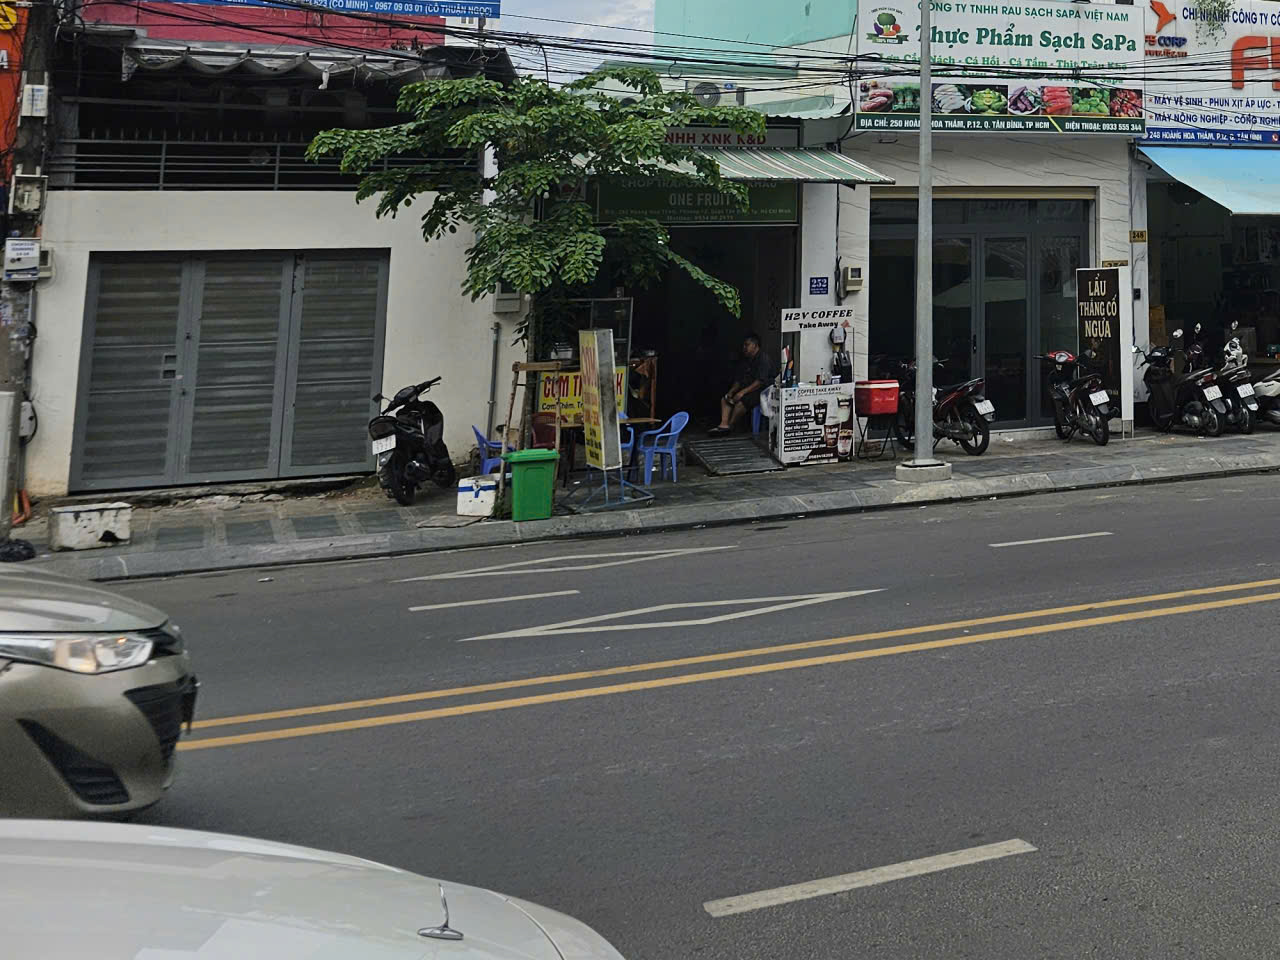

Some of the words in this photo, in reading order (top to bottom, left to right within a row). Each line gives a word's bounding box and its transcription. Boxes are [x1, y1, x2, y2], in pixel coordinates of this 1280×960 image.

[345, 0, 369, 11] MINH)
[374, 1, 393, 11] 0967
[394, 2, 403, 11] 09
[404, 3, 413, 12] 03
[414, 4, 423, 13] 01
[955, 3, 967, 13] TY
[971, 4, 998, 15] TNHH
[1001, 5, 1022, 16] RAU
[1024, 7, 1053, 19] SẠCH
[1056, 9, 1081, 19] SAPA
[1084, 10, 1104, 22] VIỆT
[1106, 12, 1129, 22] NAM
[1232, 8, 1258, 24] CÔNG
[1259, 13, 1269, 25] TY
[915, 24, 969, 48] hực
[976, 23, 1033, 47] Phẩm
[1039, 30, 1085, 53] Sạch
[1091, 33, 1137, 52] SaPa
[964, 55, 979, 65] Cá
[1008, 57, 1023, 67] Cá
[1154, 94, 1172, 105] MÁY
[1186, 97, 1203, 107] SINH
[1209, 98, 1230, 107] PHUN
[1231, 99, 1243, 109] XỊT
[1245, 98, 1256, 108] ÁP
[1257, 100, 1272, 110] LỰC
[860, 118, 873, 128] ĐỊA
[889, 119, 903, 127] 250
[992, 120, 1005, 128] TÂN
[1034, 121, 1050, 129] HCM
[1065, 121, 1081, 131] ĐIỆN
[1102, 123, 1118, 131] 0933
[1118, 123, 1130, 131] 555
[1130, 123, 1142, 131] 344
[1174, 112, 1198, 123] NÔNG
[1200, 113, 1229, 125] NGHIỆP
[1234, 113, 1257, 125] CÔNG
[665, 133, 696, 144] NHH
[701, 133, 732, 145] XNK
[1149, 131, 1161, 139] 248
[669, 193, 694, 206] ONE
[697, 193, 731, 206] FRUIT
[1132, 231, 1144, 239] 248
[811, 278, 828, 288] 252
[1088, 273, 1107, 297] LẨU
[1106, 294, 1117, 317] CỐ
[784, 311, 809, 321] H2V
[811, 309, 853, 319] COFFEE
[817, 321, 839, 329] Away
